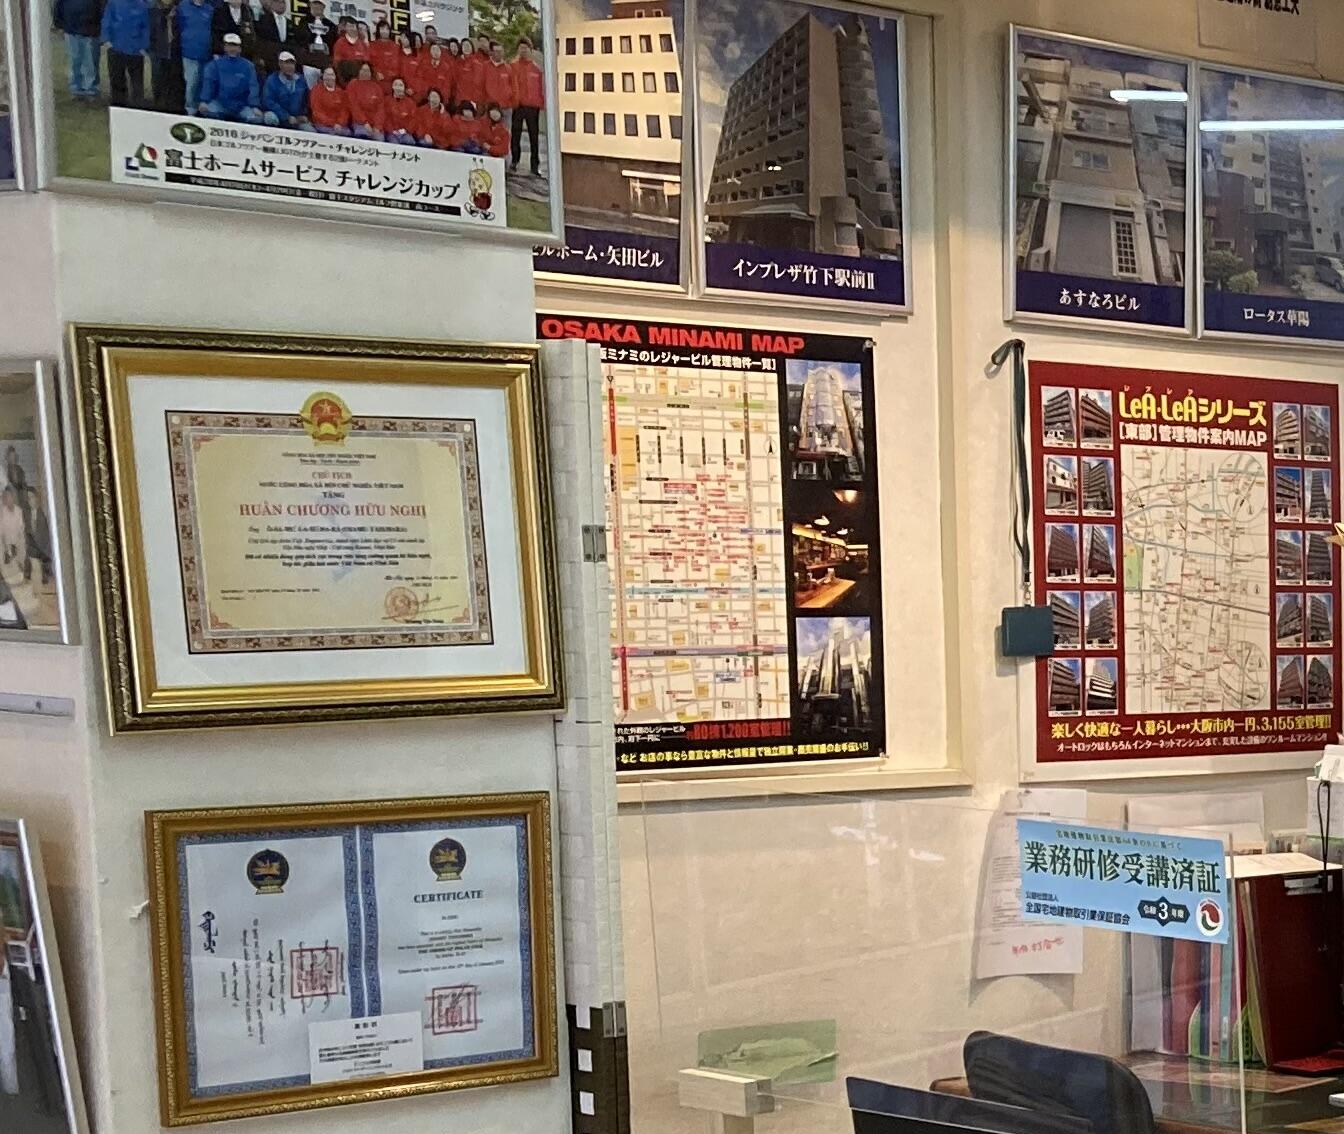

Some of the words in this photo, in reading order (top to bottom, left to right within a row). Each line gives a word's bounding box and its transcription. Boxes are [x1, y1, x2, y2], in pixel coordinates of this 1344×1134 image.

[164, 147, 330, 185] 富士ホームサービス
[335, 168, 461, 201] チャレンジカップ
[1059, 286, 1141, 312] あすなろビル
[541, 319, 641, 345] OSAKA
[648, 327, 744, 351] MINAMI
[751, 334, 805, 354] MAP
[1024, 840, 1222, 896] 業務研修受講済証
[413, 889, 484, 904] CERTIFICATE
